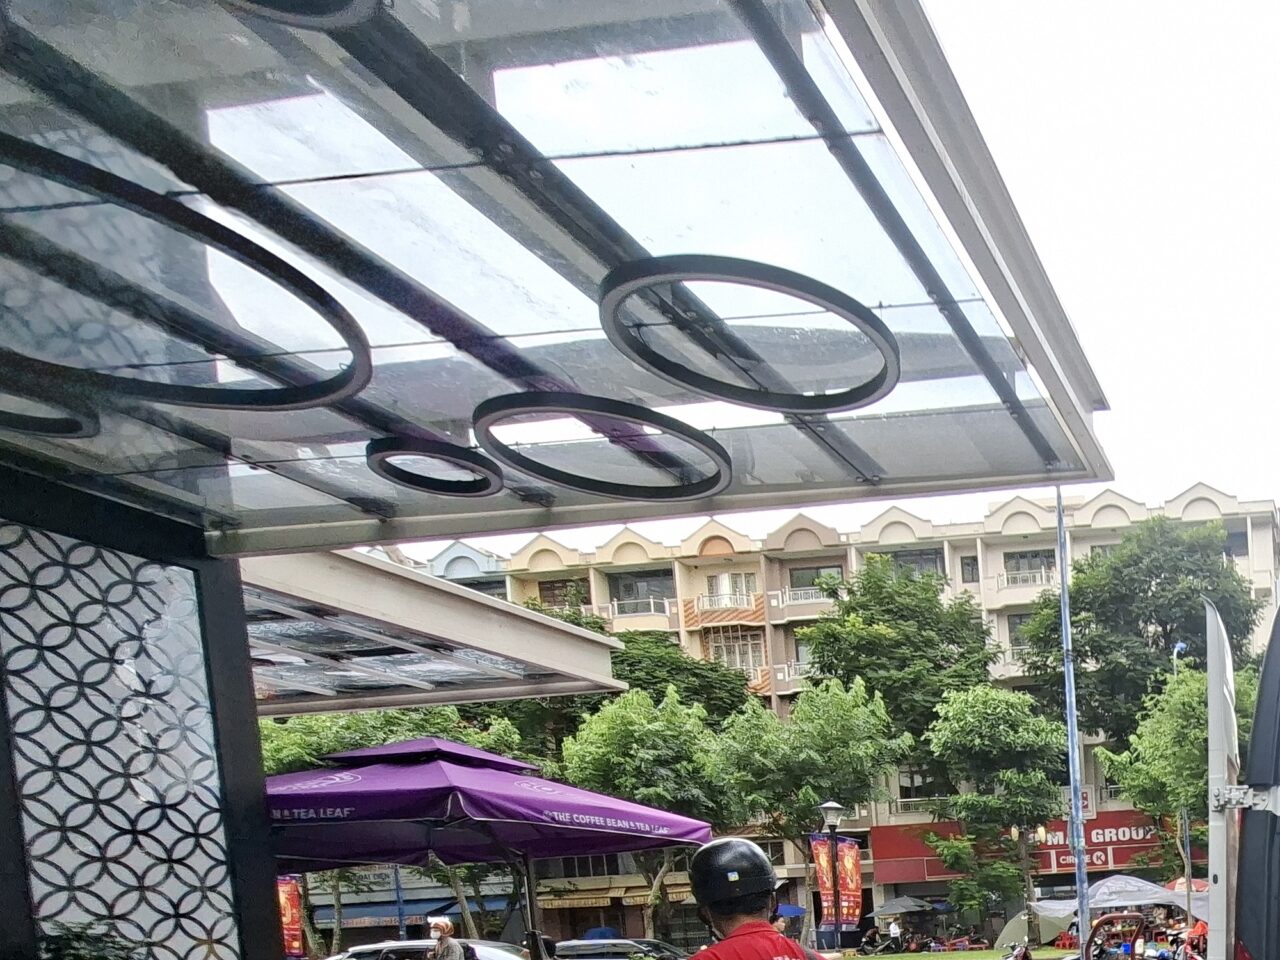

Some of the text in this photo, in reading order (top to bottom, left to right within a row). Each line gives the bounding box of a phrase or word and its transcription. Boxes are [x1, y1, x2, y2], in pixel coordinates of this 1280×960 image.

[292, 808, 317, 819] TEA
[320, 807, 351, 818] LEAF
[552, 811, 571, 822] THE
[573, 813, 605, 827] COFFEE
[606, 818, 630, 829] BEAN
[636, 822, 650, 832] TEA
[1059, 854, 1091, 864] CIRE
